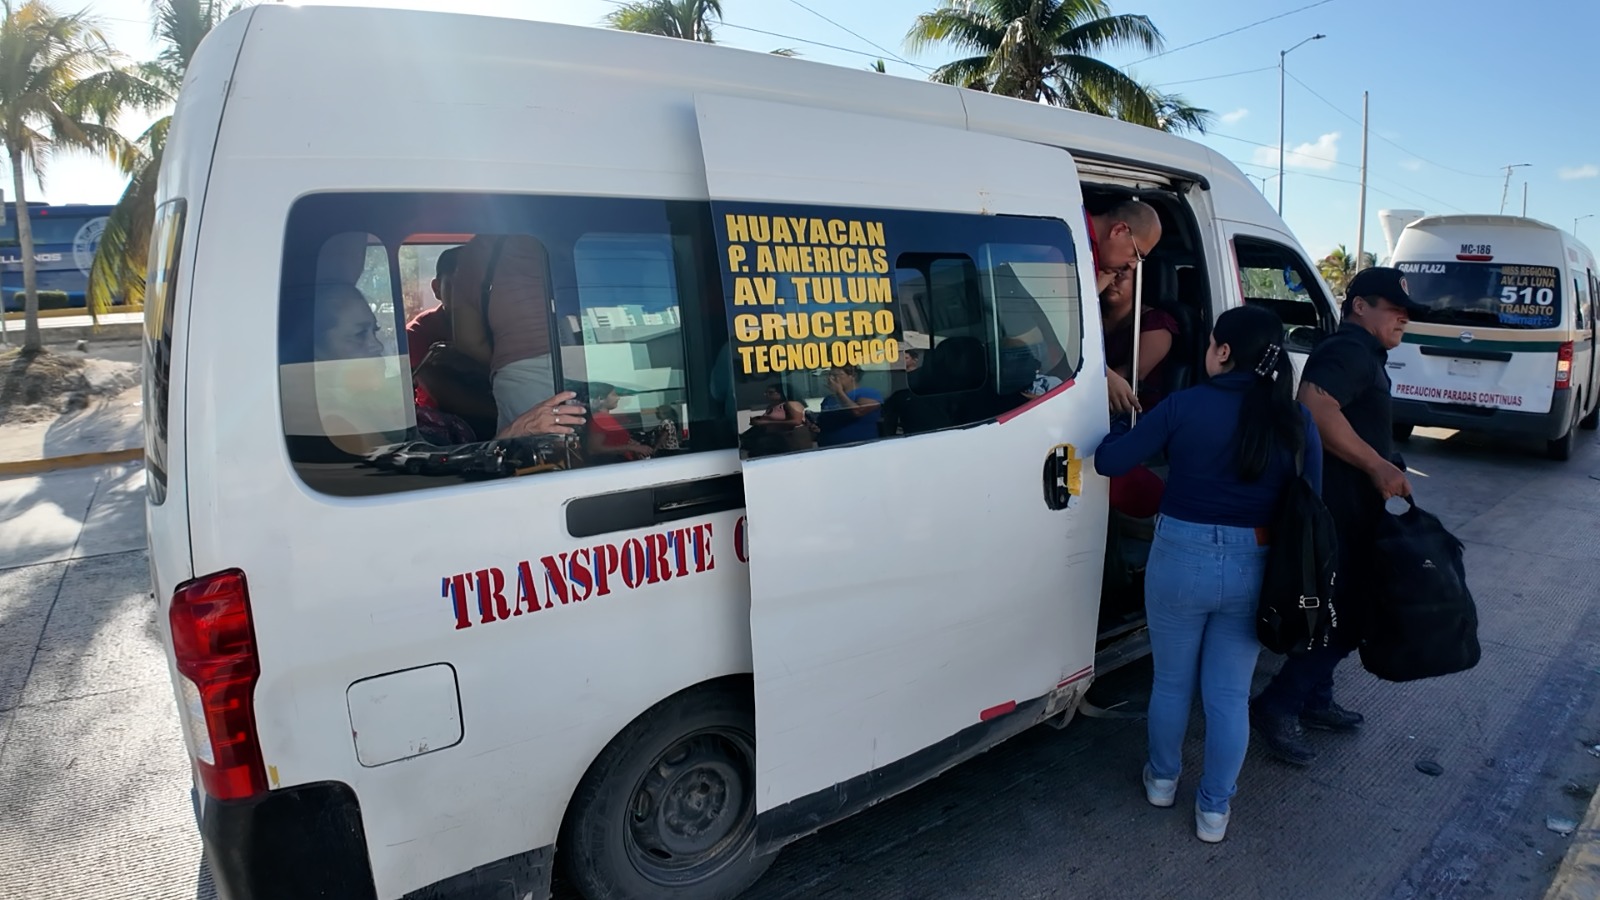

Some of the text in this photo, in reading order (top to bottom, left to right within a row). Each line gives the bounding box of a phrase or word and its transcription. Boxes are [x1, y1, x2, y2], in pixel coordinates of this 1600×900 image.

[725, 214, 886, 247] HUAYACAN
[728, 245, 889, 274] P. AMERICAS
[1460, 244, 1491, 254] MC-186
[1398, 264, 1446, 274] GRAN PLAZA
[1520, 266, 1556, 278] REGIONAL
[734, 277, 893, 306] AV. TULUM
[1516, 276, 1528, 287] LA
[1530, 277, 1555, 288] LUNA
[1500, 286, 1554, 305] 510
[1499, 304, 1554, 316] TRANSITO
[734, 310, 895, 342] CRUCERO
[738, 338, 899, 374] TECNOLOGICO
[1396, 384, 1523, 407] PRECAUCION PARADAS CONTINUAS
[441, 522, 715, 630] TRANSPORTE
